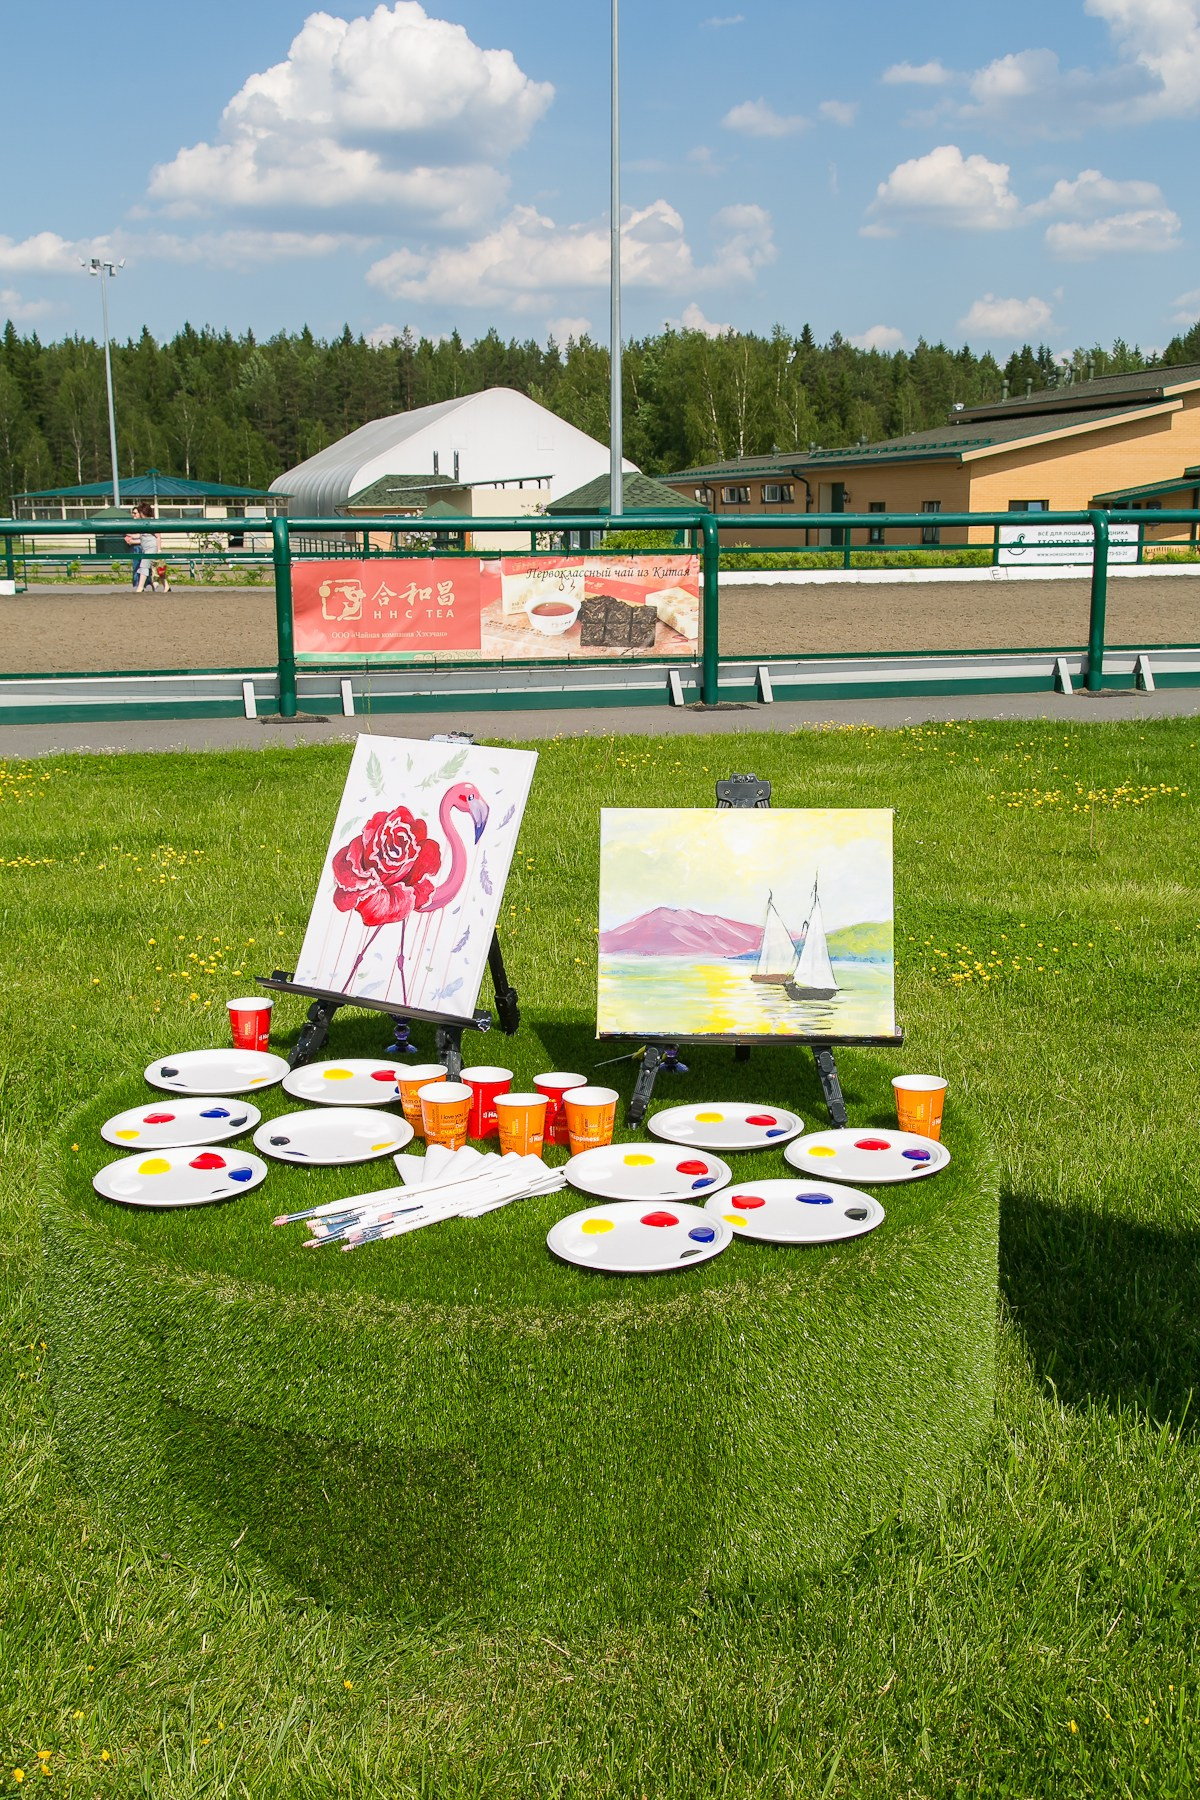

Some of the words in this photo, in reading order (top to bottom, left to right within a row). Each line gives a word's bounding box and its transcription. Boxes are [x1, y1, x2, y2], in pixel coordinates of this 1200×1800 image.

[526, 567, 611, 582] Первоклассный
[615, 566, 634, 577] чай
[638, 569, 649, 577] из
[651, 567, 691, 580] Китая
[371, 580, 455, 607] 合和昌
[425, 609, 455, 619] TEA
[331, 631, 350, 639] ООО
